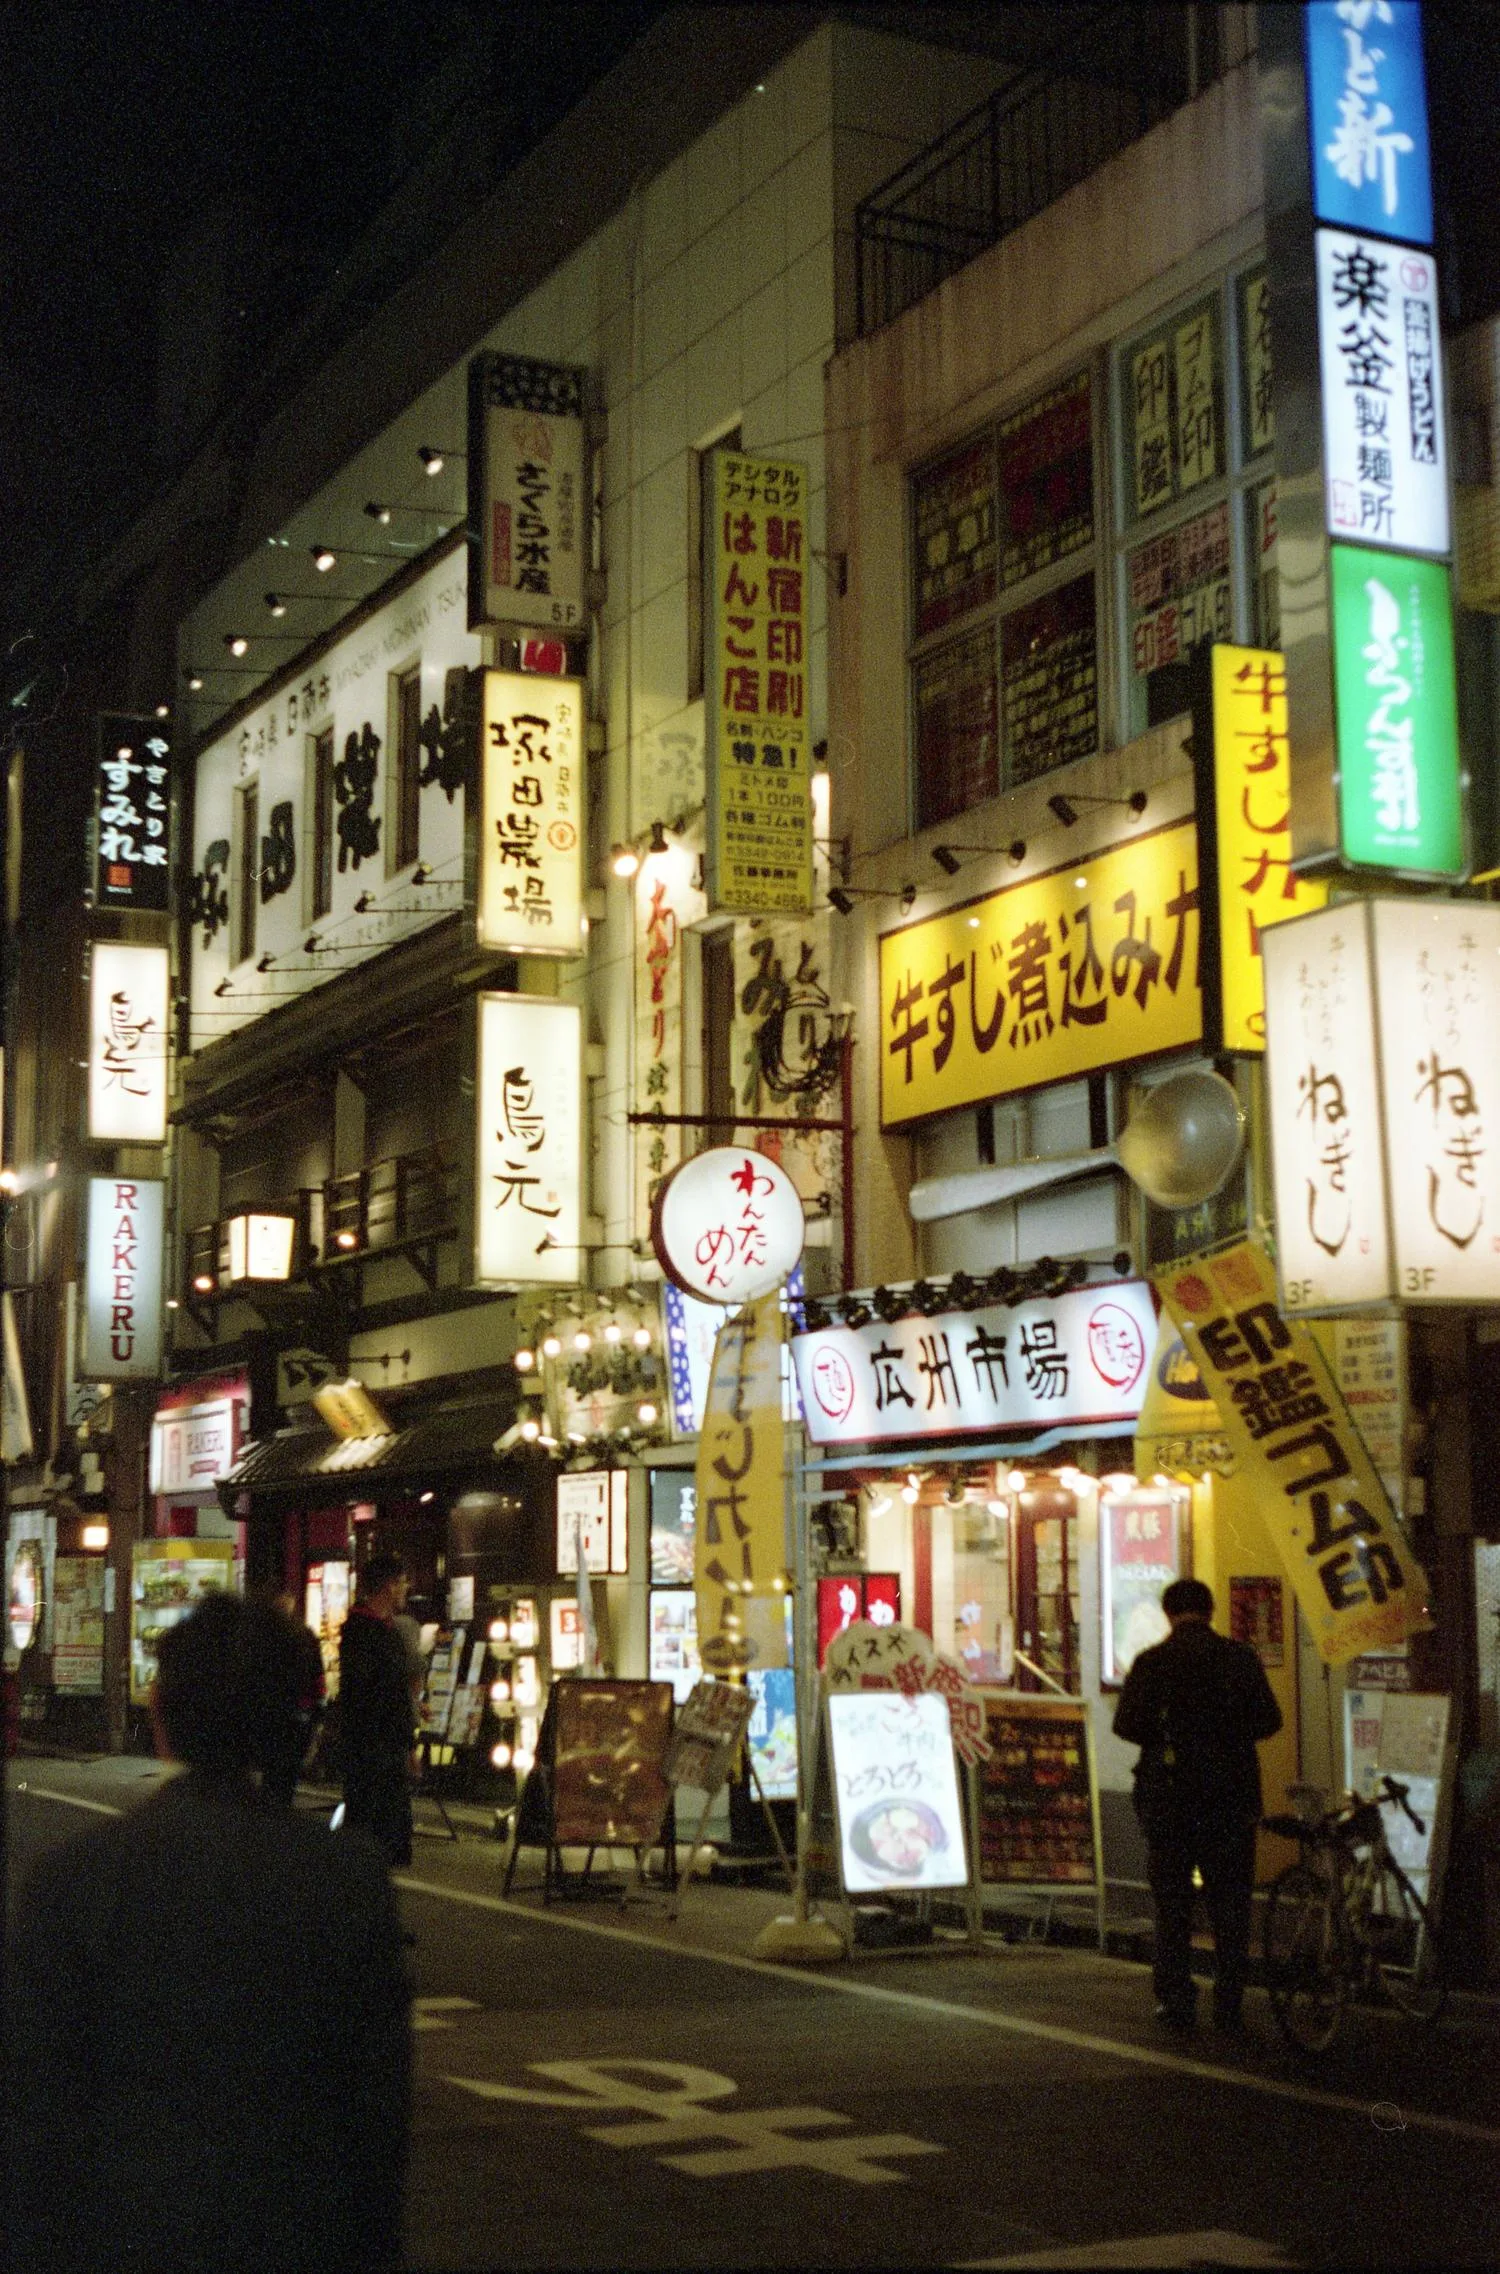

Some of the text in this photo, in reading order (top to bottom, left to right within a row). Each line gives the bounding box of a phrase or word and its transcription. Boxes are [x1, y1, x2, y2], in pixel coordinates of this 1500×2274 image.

[1331, 245, 1396, 538] 楽釜製麺所
[515, 461, 551, 594] さくら水産
[726, 482, 800, 507] アナログ
[723, 511, 759, 714] はんこ店
[766, 515, 803, 719] 新宿印刷
[99, 757, 143, 862] すみれ
[142, 737, 169, 865] やきとり家
[493, 1066, 560, 1218] 鳥元
[1297, 1060, 1352, 1257] ねぎし
[1415, 1050, 1485, 1249] ねぎし
[110, 1183, 139, 1361] RAKERU
[696, 1225, 734, 1289] めん
[730, 1158, 775, 1267] わんたん
[1285, 1279, 1312, 1305] 3F
[1406, 1269, 1436, 1292] 3F
[870, 1320, 1069, 1411] 広州市場
